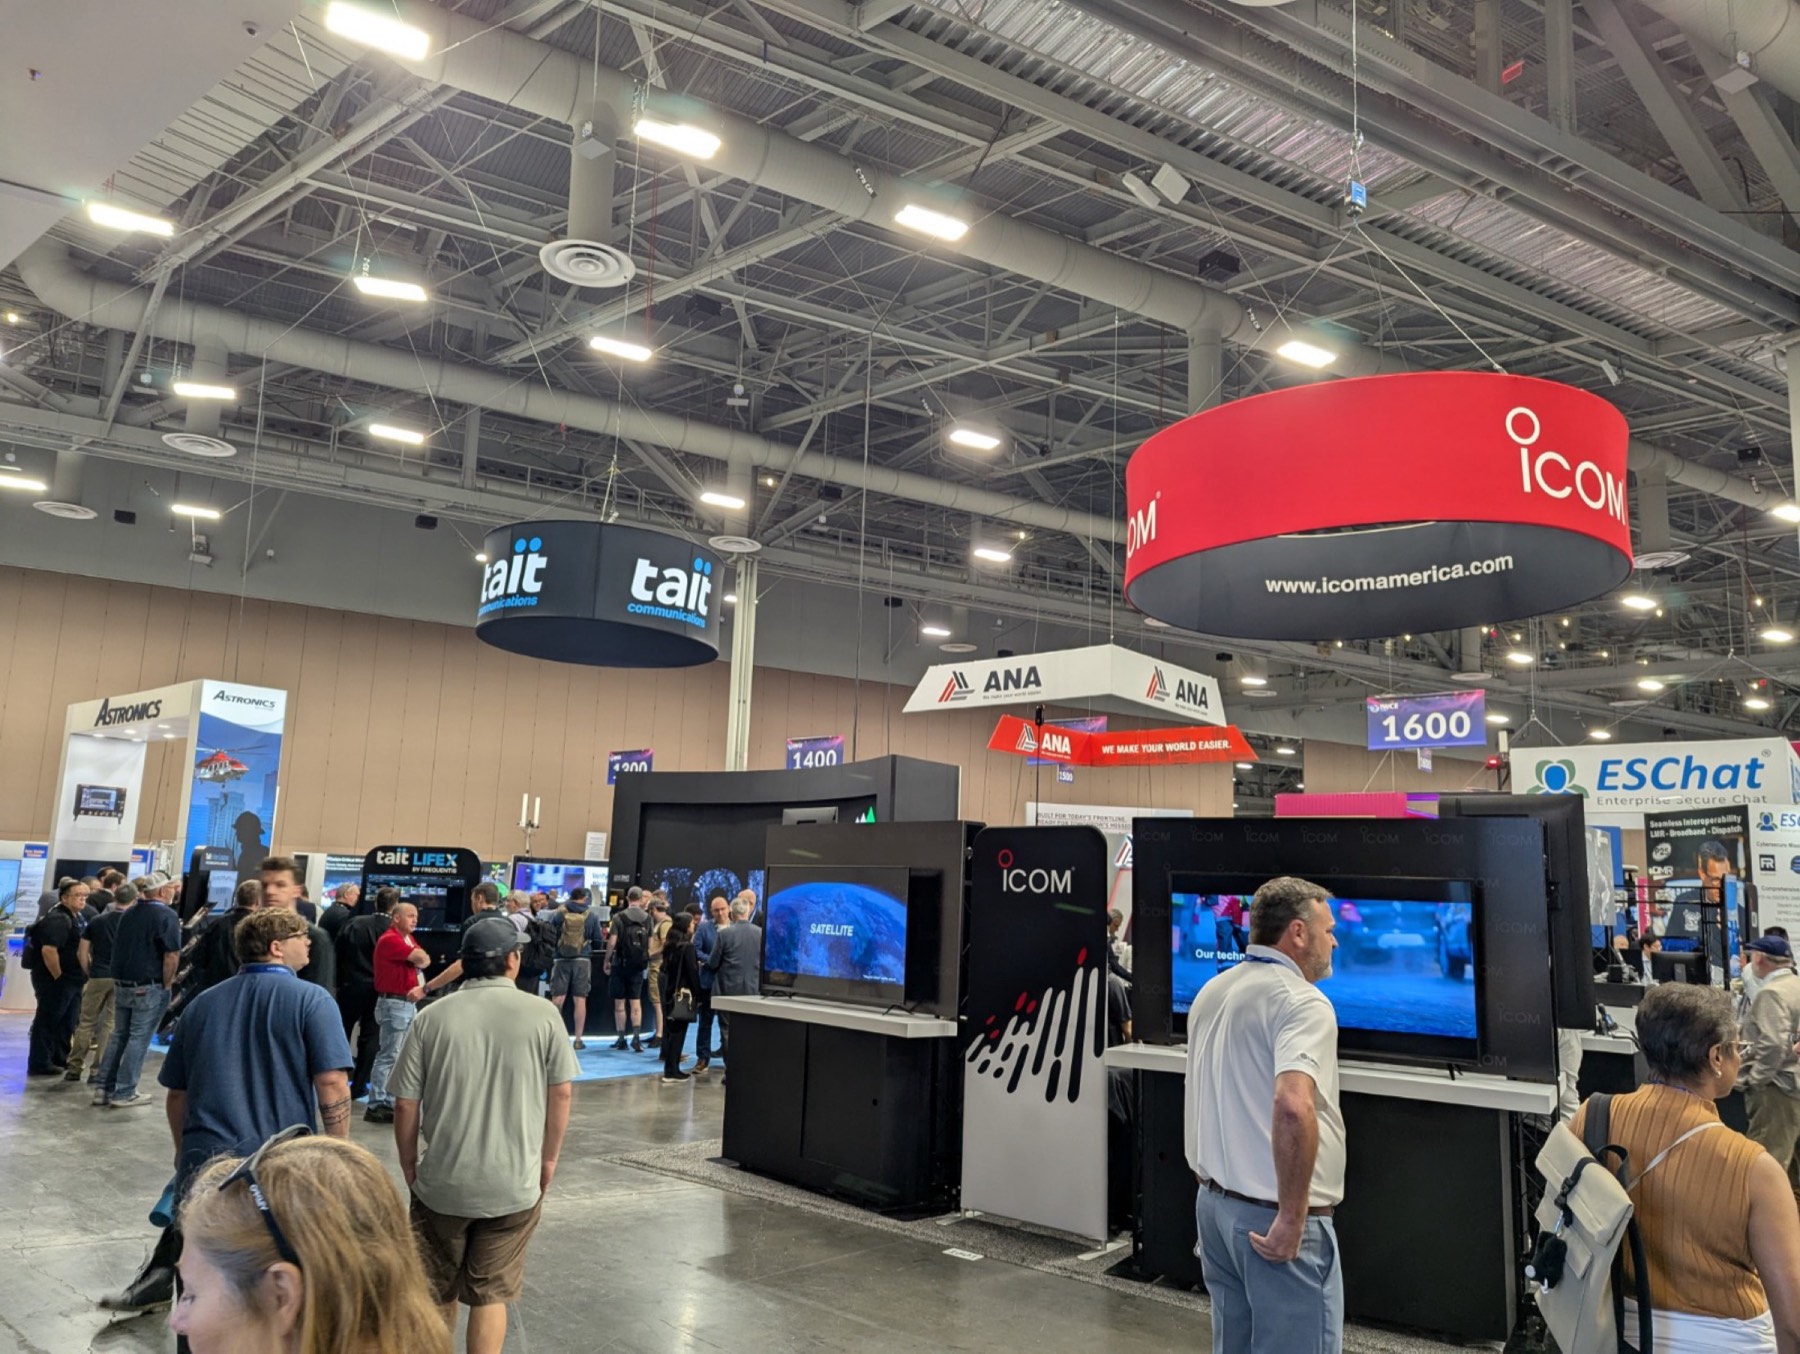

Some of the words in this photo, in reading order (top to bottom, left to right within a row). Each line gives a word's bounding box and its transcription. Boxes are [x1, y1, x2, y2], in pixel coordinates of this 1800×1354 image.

[480, 537, 548, 603] tait
[1265, 555, 1514, 594] www.icomamerica.com
[631, 557, 712, 616] tait
[983, 665, 1042, 692] ANA
[1175, 678, 1208, 710] ANA
[1382, 711, 1471, 741] 1600
[1041, 732, 1072, 755] ANA
[1102, 745, 1114, 754] WE
[1117, 744, 1139, 754] MAKE
[1141, 743, 1163, 753] YOUR
[1165, 741, 1196, 752] WORLD
[793, 750, 837, 769] 1400
[1597, 755, 1765, 791] ESChat
[1597, 796, 1671, 807] Enterprise
[1676, 794, 1726, 805] Secure
[1732, 793, 1767, 805] Chat
[1781, 813, 1800, 827] ES
[1712, 825, 1743, 835] Dispatch
[376, 848, 409, 865] tait
[413, 852, 458, 867] LIFEX
[421, 867, 457, 875] FREQUENTIS
[810, 923, 854, 937] SATELLITE
[1195, 948, 1214, 958] Our
